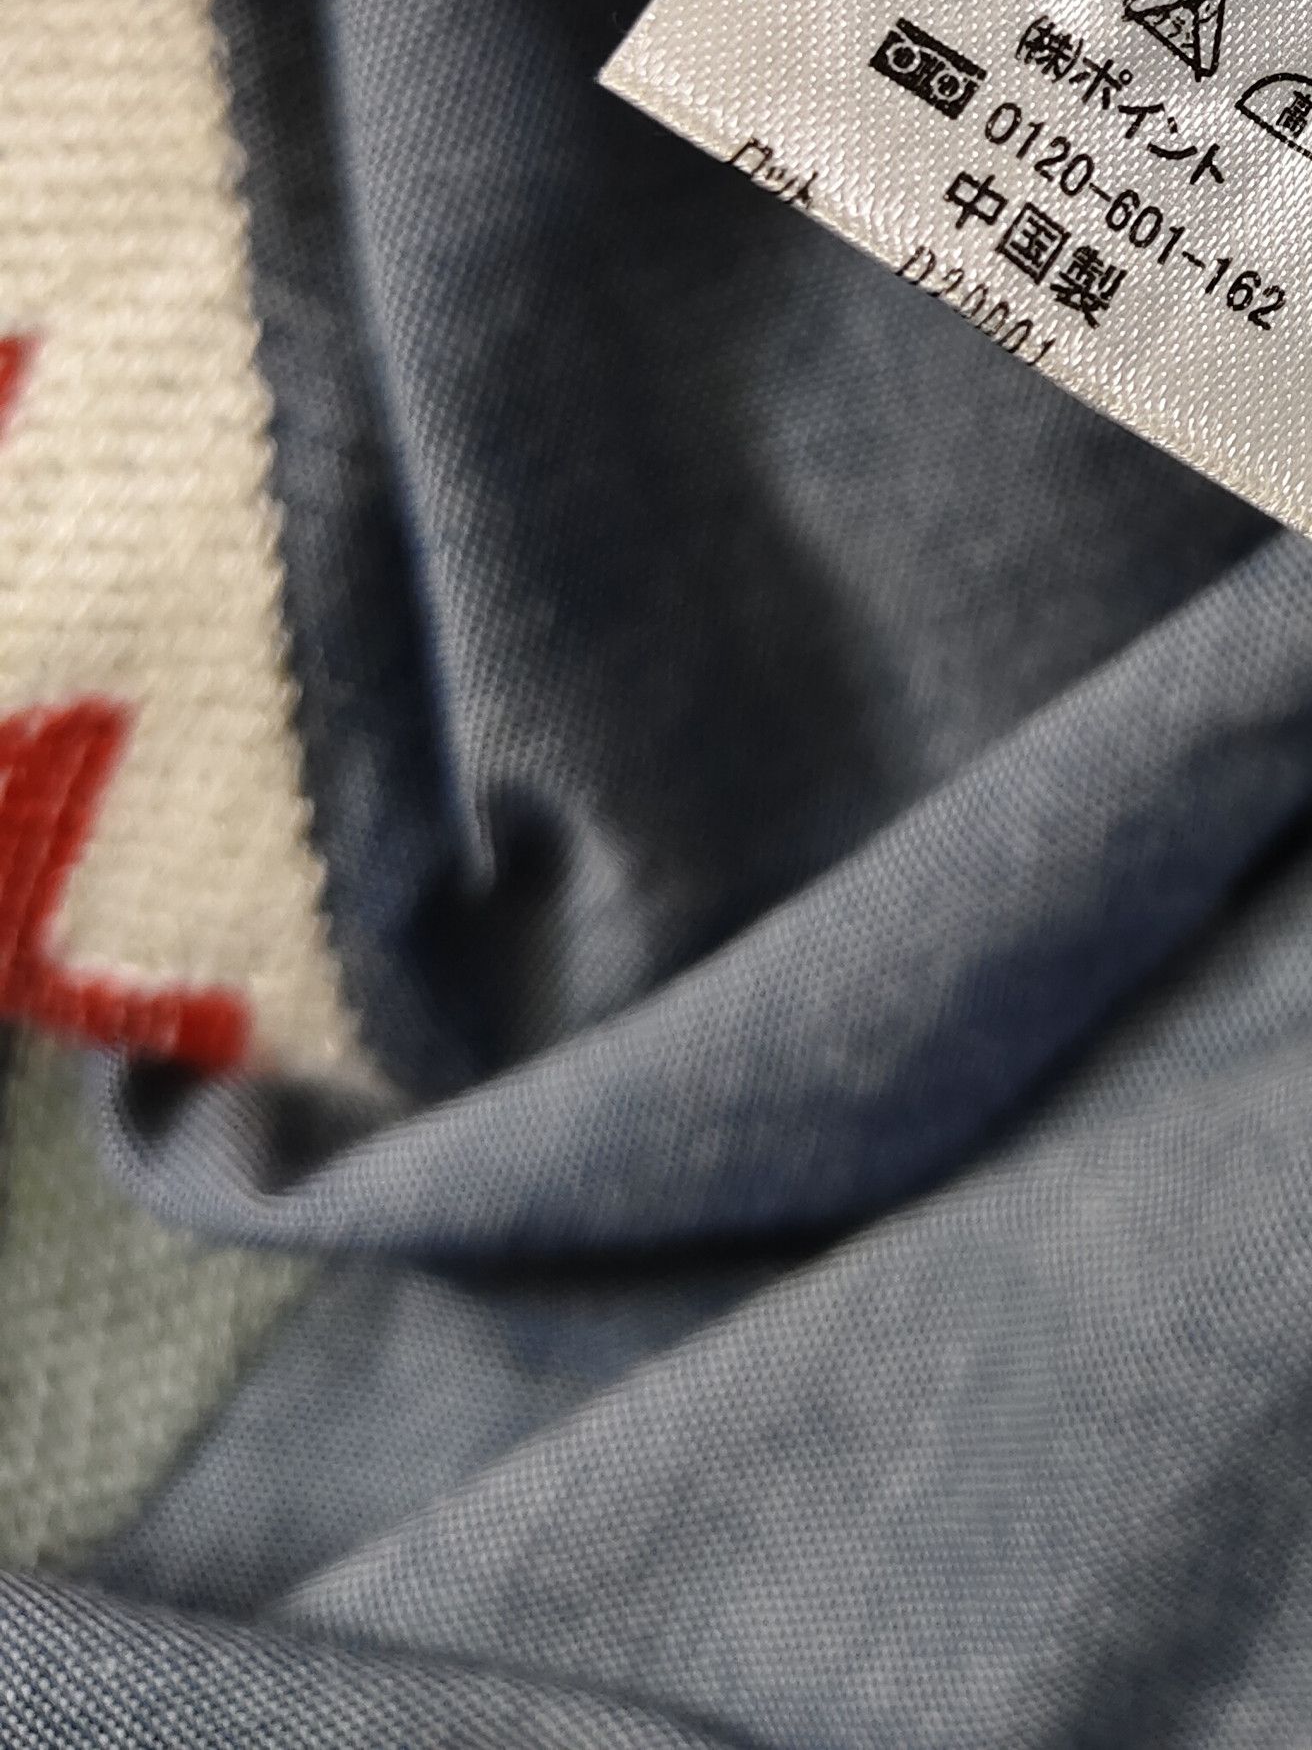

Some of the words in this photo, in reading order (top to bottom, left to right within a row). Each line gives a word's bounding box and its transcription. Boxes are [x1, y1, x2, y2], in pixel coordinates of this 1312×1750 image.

[944, 171, 1129, 328] 中国製
[984, 102, 1287, 331] 0120-601-162
